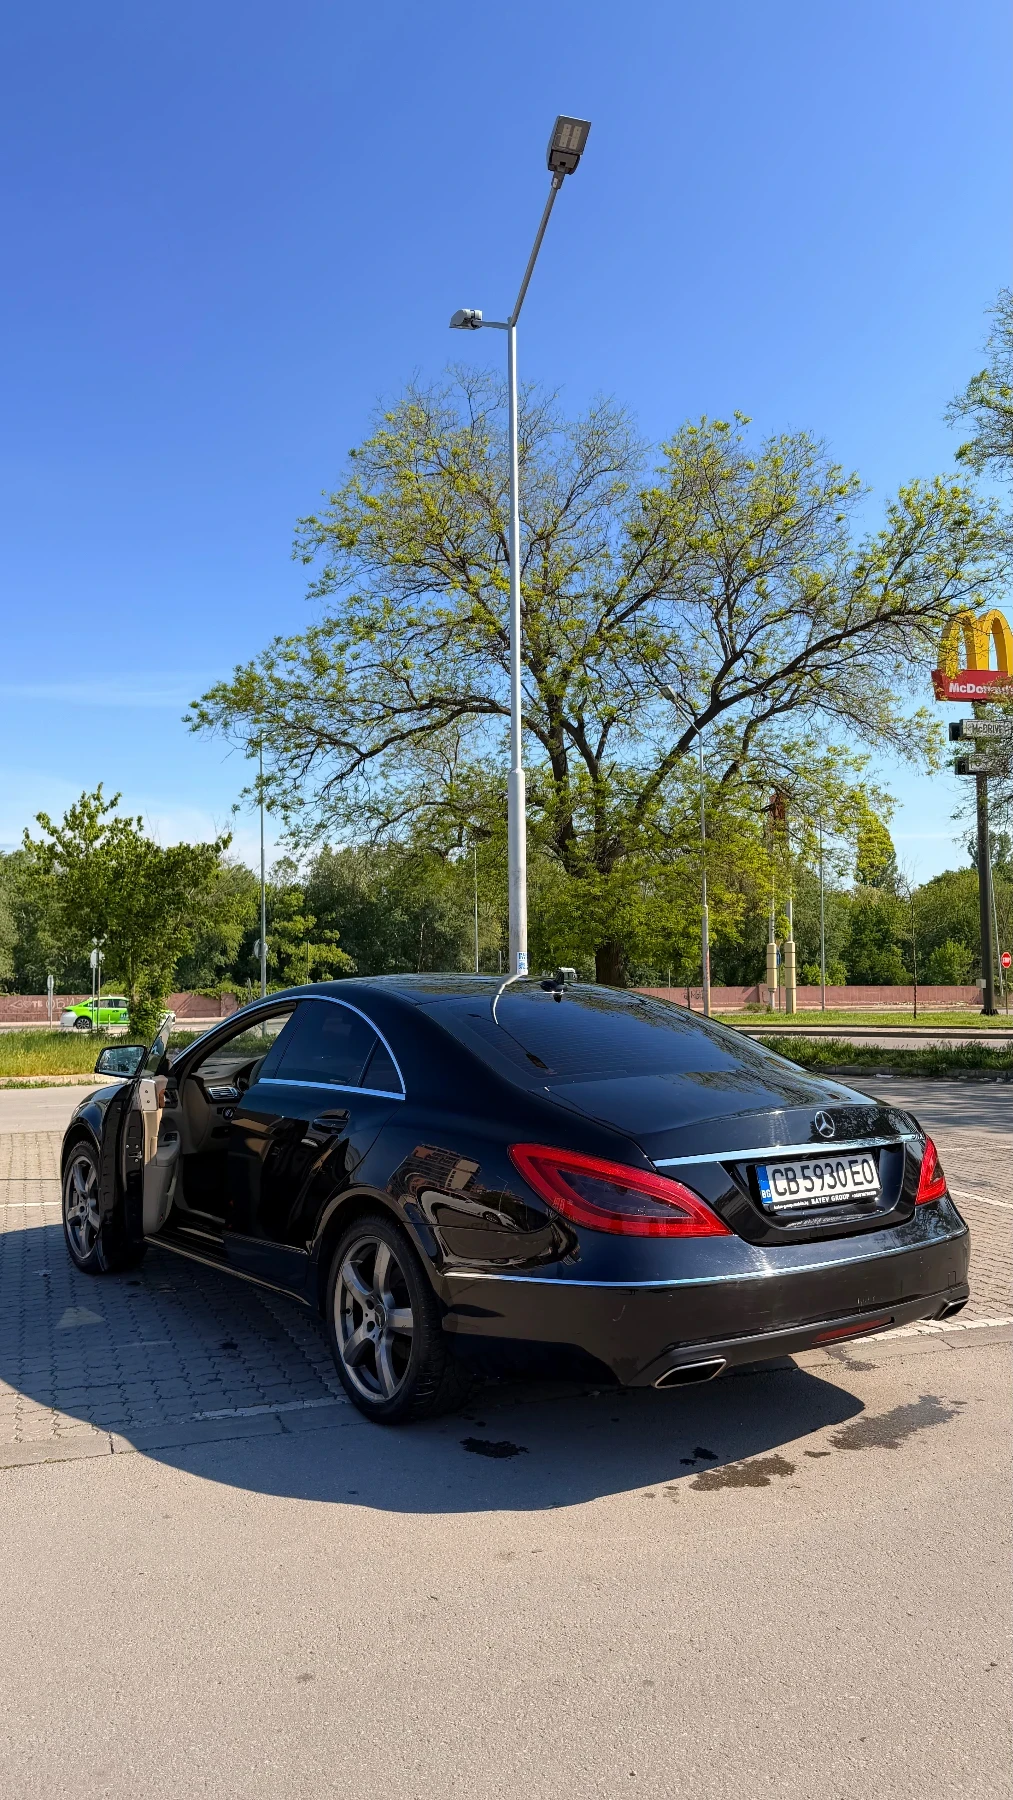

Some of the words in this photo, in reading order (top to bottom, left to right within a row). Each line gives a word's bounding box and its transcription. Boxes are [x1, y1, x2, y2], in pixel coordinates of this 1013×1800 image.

[772, 1166, 800, 1196] CB
[800, 1161, 848, 1192] 5930
[848, 1158, 874, 1186] EO
[761, 1189, 772, 1199] BG
[831, 1193, 850, 1203] GROUP
